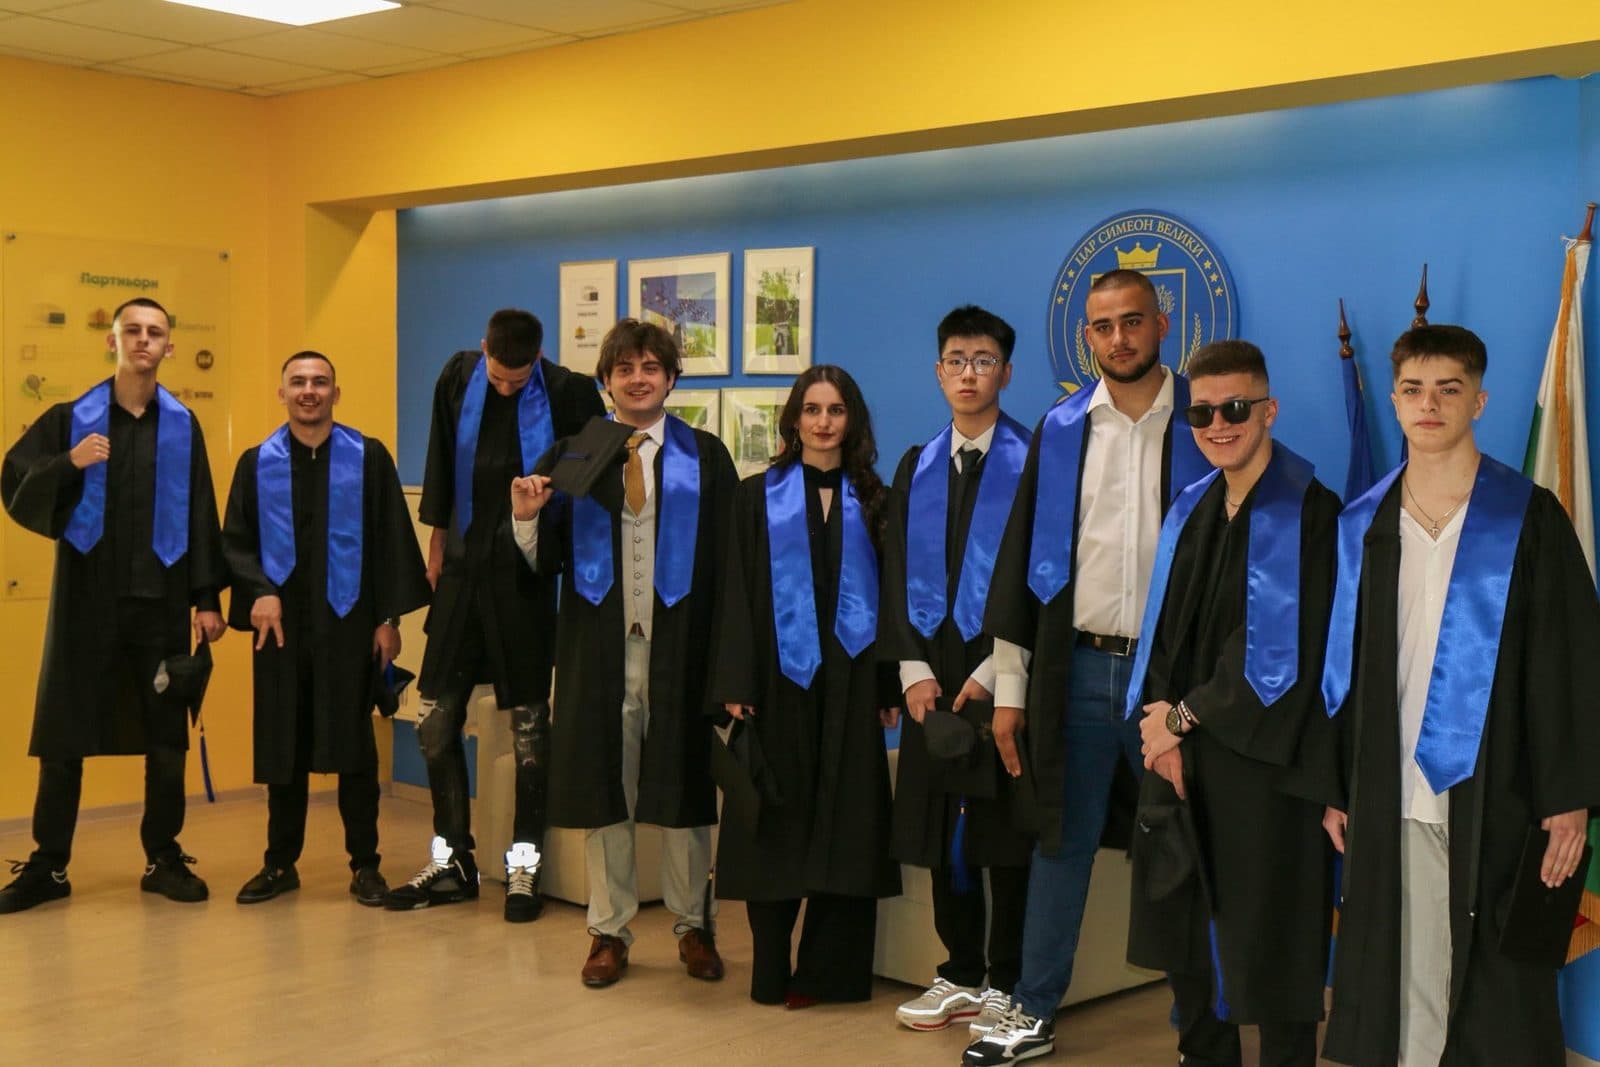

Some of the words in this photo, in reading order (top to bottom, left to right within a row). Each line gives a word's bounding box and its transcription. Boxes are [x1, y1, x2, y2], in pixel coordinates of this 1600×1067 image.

[1075, 239, 1096, 266] ЦАР
[1098, 219, 1154, 244] СИМЕОН
[1157, 221, 1204, 258] ВЕЛИКИ
[80, 272, 159, 290] Партньори
